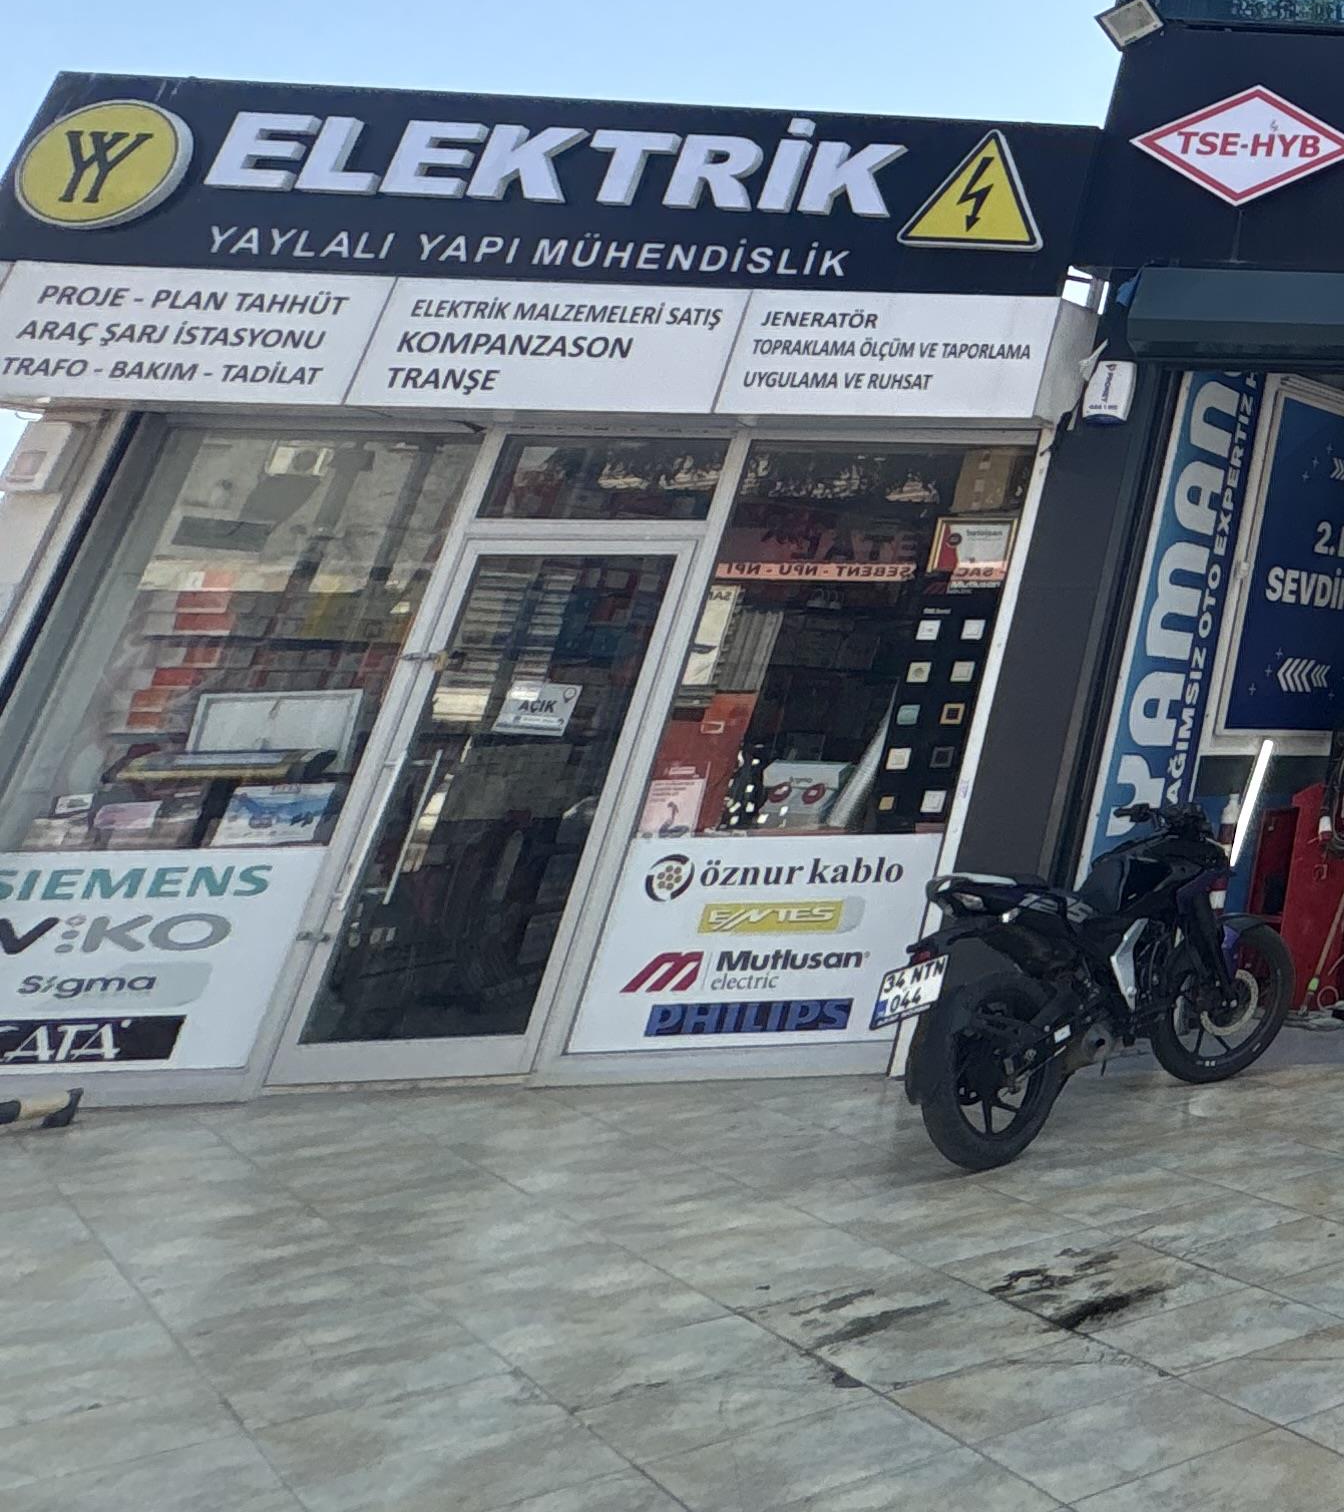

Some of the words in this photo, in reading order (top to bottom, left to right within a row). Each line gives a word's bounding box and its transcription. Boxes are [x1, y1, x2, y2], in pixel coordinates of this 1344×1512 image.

[1176, 131, 1322, 159] TSE-HYB
[204, 112, 909, 218] ELEKTRİK
[208, 226, 398, 260] YAYLALI
[417, 234, 519, 265] YAPI
[531, 234, 850, 277] MÜHENDİSLİK
[37, 285, 129, 308] PROJE
[151, 290, 224, 312] PLAN
[234, 291, 350, 316] TAHHÜT
[410, 296, 511, 320] ELEKTRİK
[513, 301, 665, 325] MALZEMELERİ
[666, 306, 724, 330] SATIŞ
[760, 309, 878, 330] JENERATÖR
[16, 320, 97, 345] ARAÇ
[100, 323, 169, 347] ŞARJ
[173, 323, 326, 350] İSTASYONU
[396, 330, 634, 360] KOMPANZASON
[752, 338, 856, 359] TOPRAKLAMA
[861, 337, 917, 363] ÖLÇÜM
[918, 343, 940, 359] VE
[940, 343, 1032, 361] TAPORLAMA
[1, 357, 88, 379] TRAFO
[108, 360, 199, 382] BAKIM
[221, 361, 324, 386] TADİLAT
[387, 366, 501, 395] TRANŞE
[743, 370, 839, 390] UYGULAMA
[844, 373, 865, 390] VE
[867, 373, 934, 391] RUHSAT
[1198, 563, 1222, 639] OTO
[518, 699, 558, 713] AÇIK
[700, 859, 804, 887] öznur
[808, 856, 904, 885] kablo
[716, 950, 864, 972] Mutlusan
[710, 972, 780, 991] electric
[649, 1000, 850, 1036] PHILIPS
